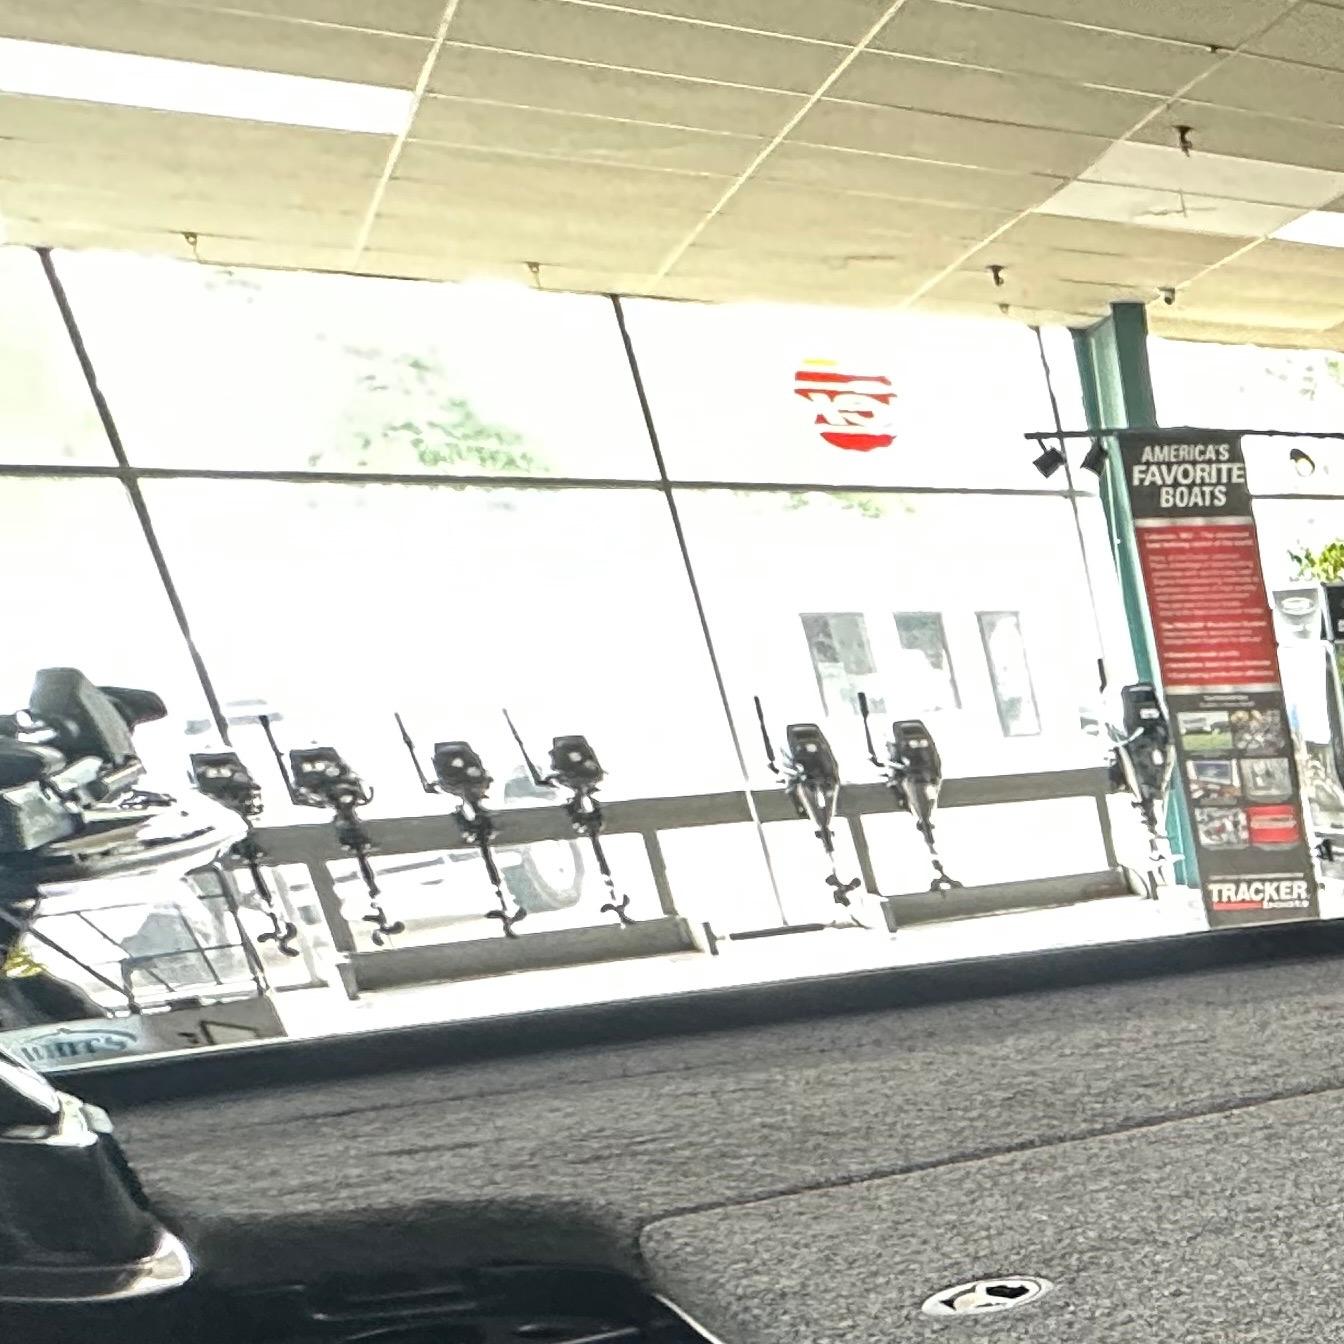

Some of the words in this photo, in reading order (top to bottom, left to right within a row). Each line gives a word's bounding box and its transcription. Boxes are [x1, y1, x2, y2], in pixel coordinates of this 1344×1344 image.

[1141, 443, 1231, 463] AMERICA'S
[1132, 462, 1246, 487] FAVORITE
[1159, 485, 1228, 508] BOATS
[1207, 880, 1308, 903] TRACKER
